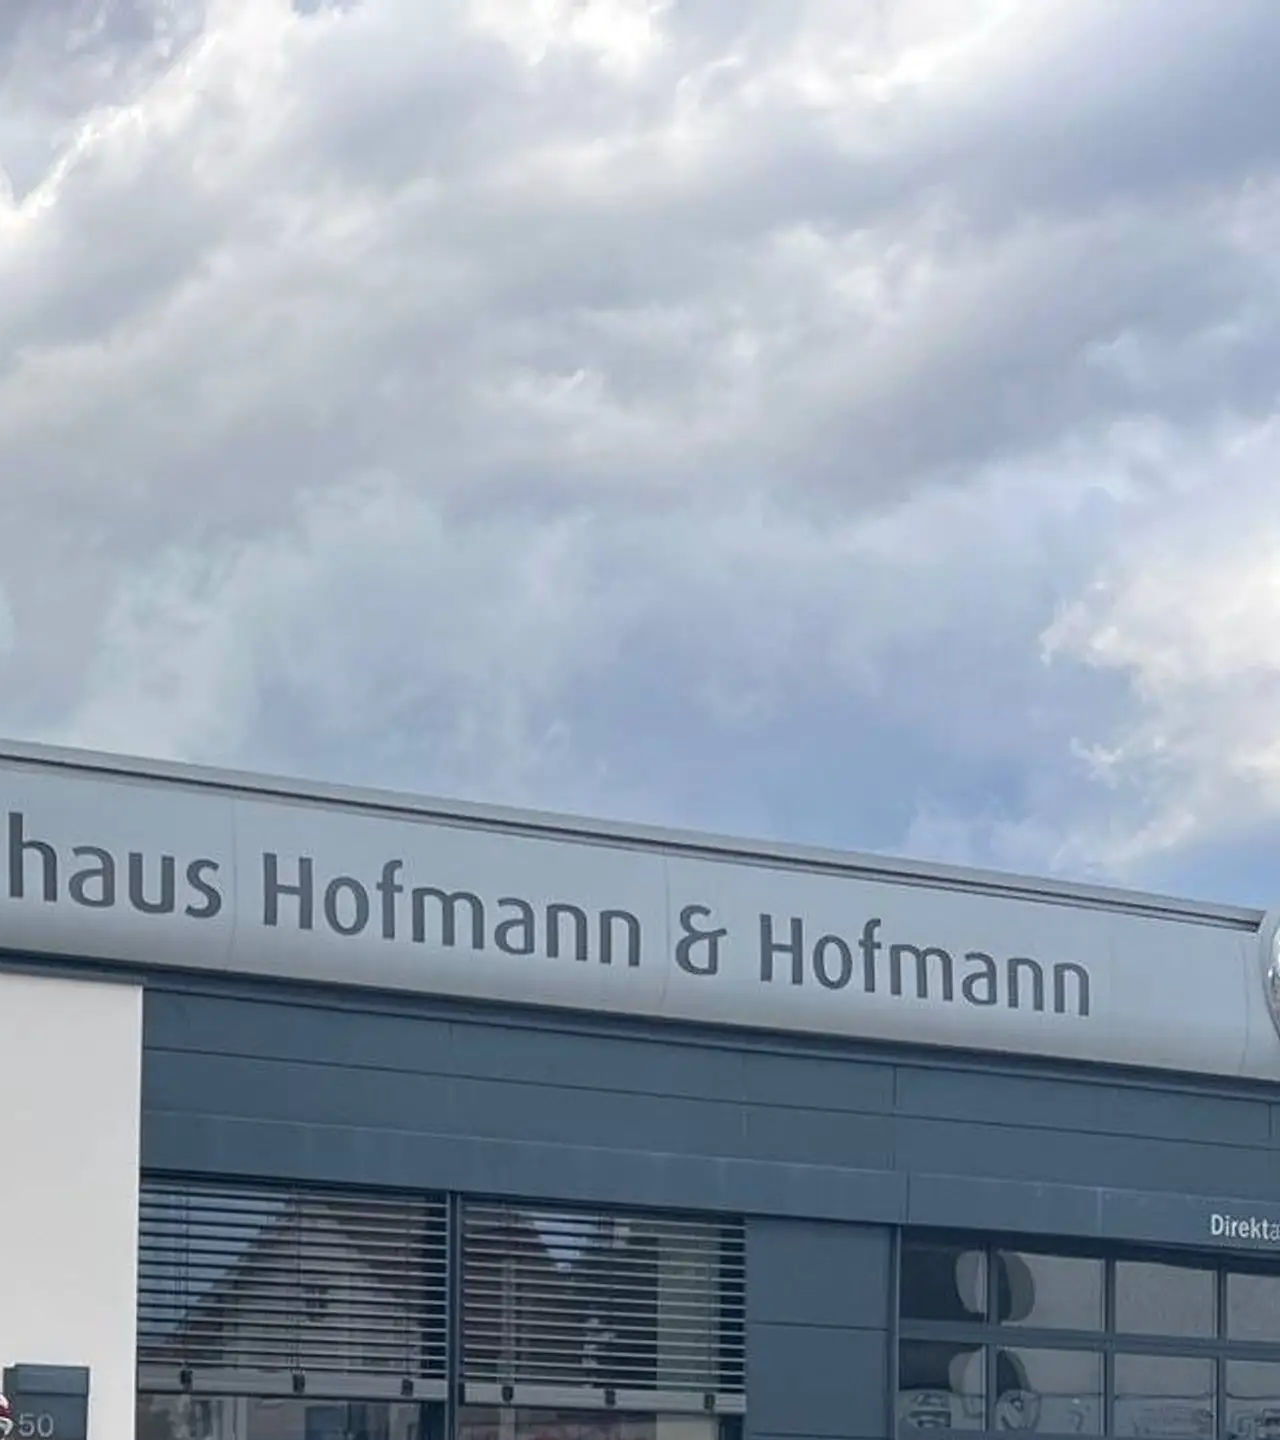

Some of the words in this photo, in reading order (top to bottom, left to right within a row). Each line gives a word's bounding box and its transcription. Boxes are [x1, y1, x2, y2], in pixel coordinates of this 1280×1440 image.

[262, 851, 641, 968] Hofmann
[675, 903, 728, 976] &
[758, 912, 1090, 1017] Hofmann
[18, 1413, 54, 1438] 50
